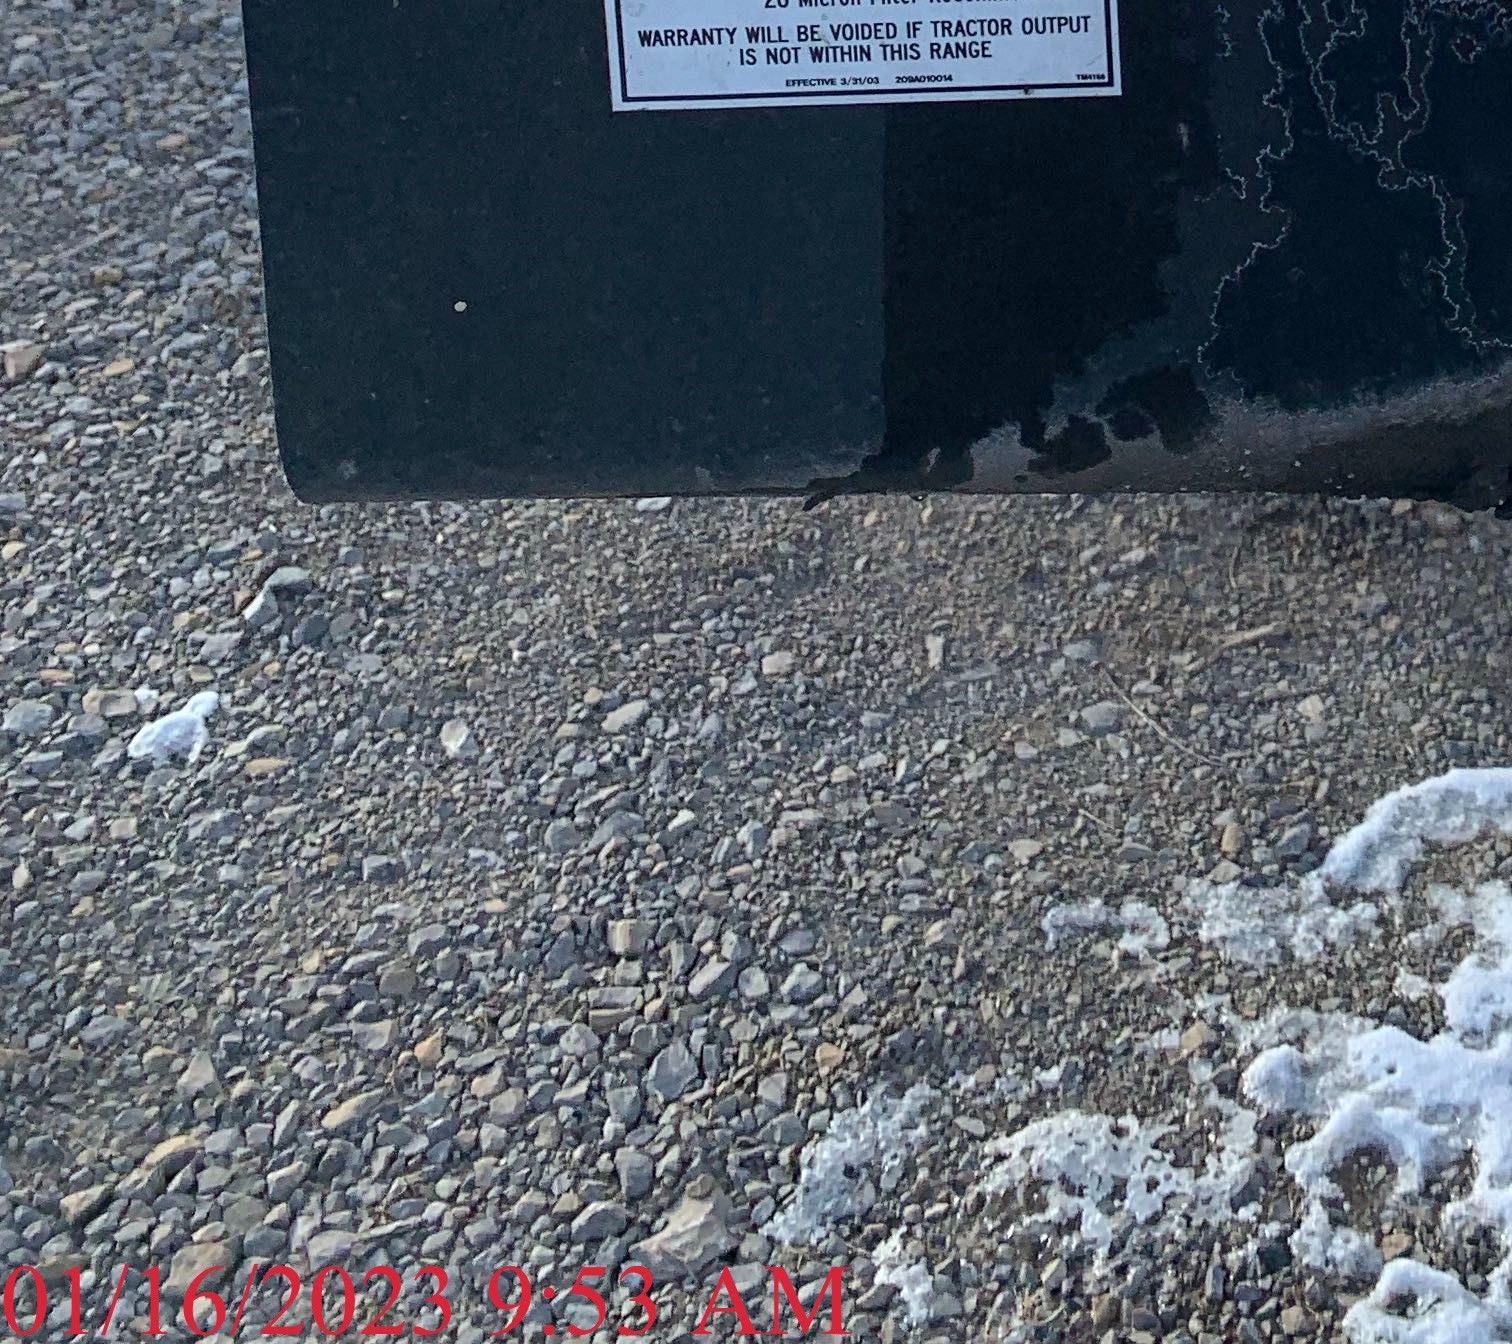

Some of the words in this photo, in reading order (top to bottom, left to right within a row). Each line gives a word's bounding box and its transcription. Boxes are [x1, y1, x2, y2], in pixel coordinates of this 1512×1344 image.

[638, 27, 737, 47] WARRANTY
[745, 26, 789, 43] WILL
[797, 25, 822, 42] BE
[830, 23, 897, 41] VOIDED
[907, 21, 922, 38] IF
[930, 19, 1012, 37] TRACTOR
[1022, 16, 1091, 35] OUTPUT
[740, 48, 757, 65] IS
[766, 47, 801, 64] NOT
[809, 45, 871, 63] WITHIN
[879, 43, 920, 61] THIS
[930, 41, 992, 59] RANGE
[786, 78, 836, 87] EFFECTIVE
